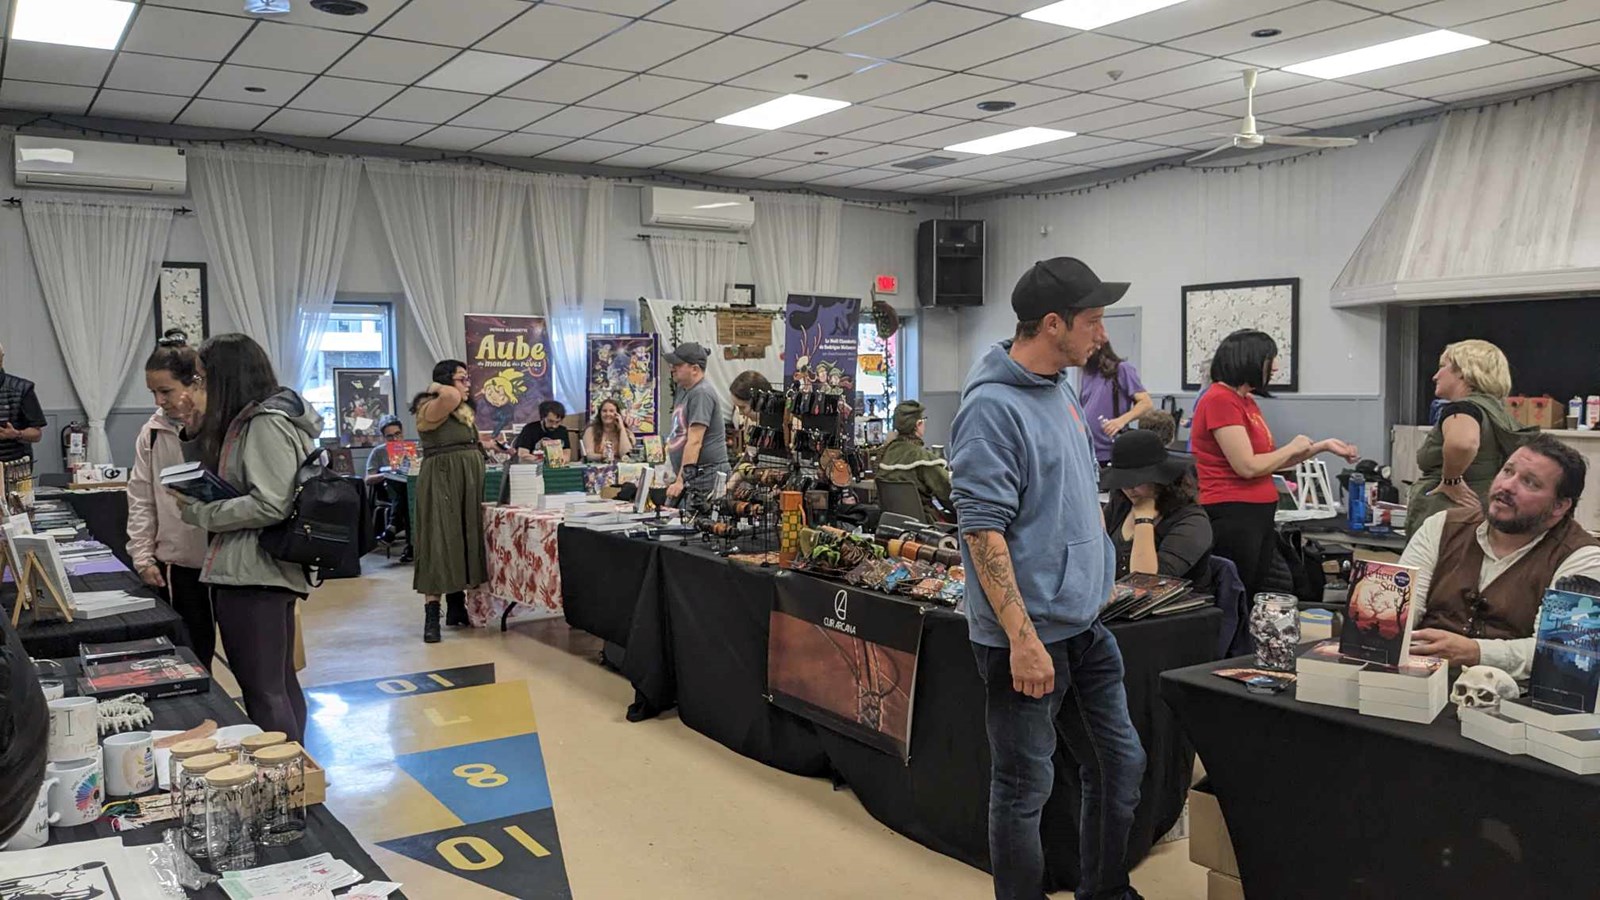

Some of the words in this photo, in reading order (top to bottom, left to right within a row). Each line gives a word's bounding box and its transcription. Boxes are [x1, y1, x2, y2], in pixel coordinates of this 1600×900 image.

[475, 334, 546, 360] Aube
[452, 763, 509, 788] 8
[435, 825, 552, 871] 10
